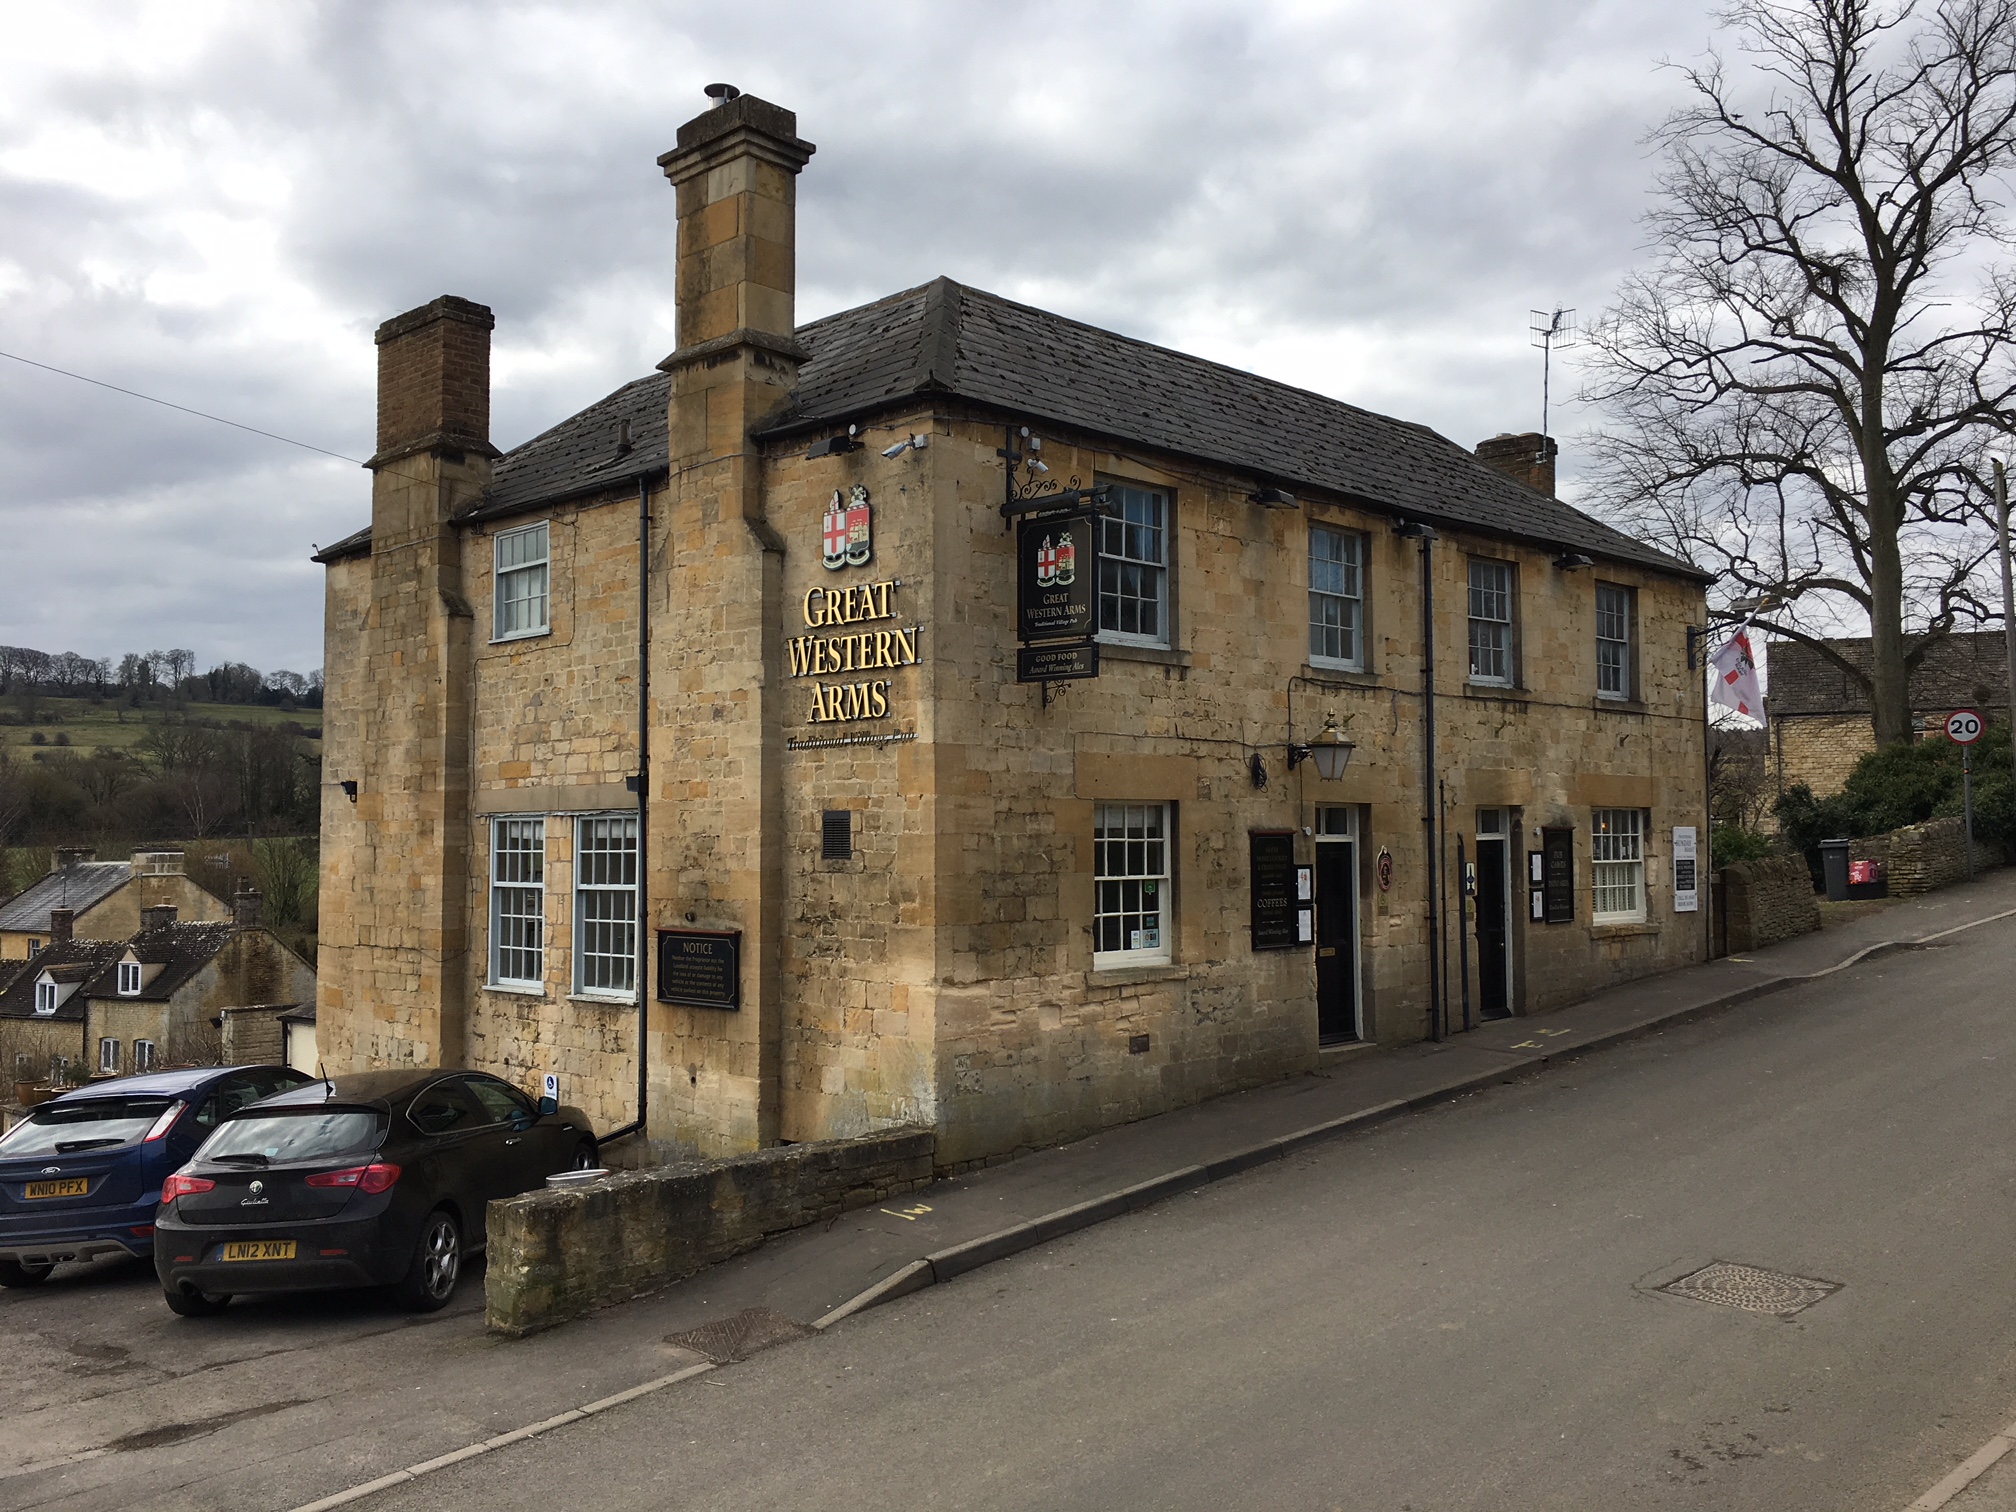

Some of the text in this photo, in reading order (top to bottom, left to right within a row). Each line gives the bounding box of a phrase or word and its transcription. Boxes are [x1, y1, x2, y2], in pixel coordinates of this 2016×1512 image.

[803, 580, 895, 628] GREAT
[1043, 592, 1068, 605] GREAT
[1026, 603, 1086, 619] WESTERN ARMS
[787, 627, 918, 677] WESTERN
[1035, 652, 1078, 663] GOOD FOOD
[1029, 665, 1048, 674] Award
[1073, 662, 1084, 671] Ales
[807, 680, 887, 723] ARMS
[1950, 719, 1979, 734] 20
[787, 727, 914, 751] Traditional Village Pub
[1257, 897, 1288, 908] COFFEES
[683, 942, 713, 955] NOTICE
[29, 1178, 84, 1198] WN10 PFX
[228, 1241, 291, 1259] LN12 XNT
